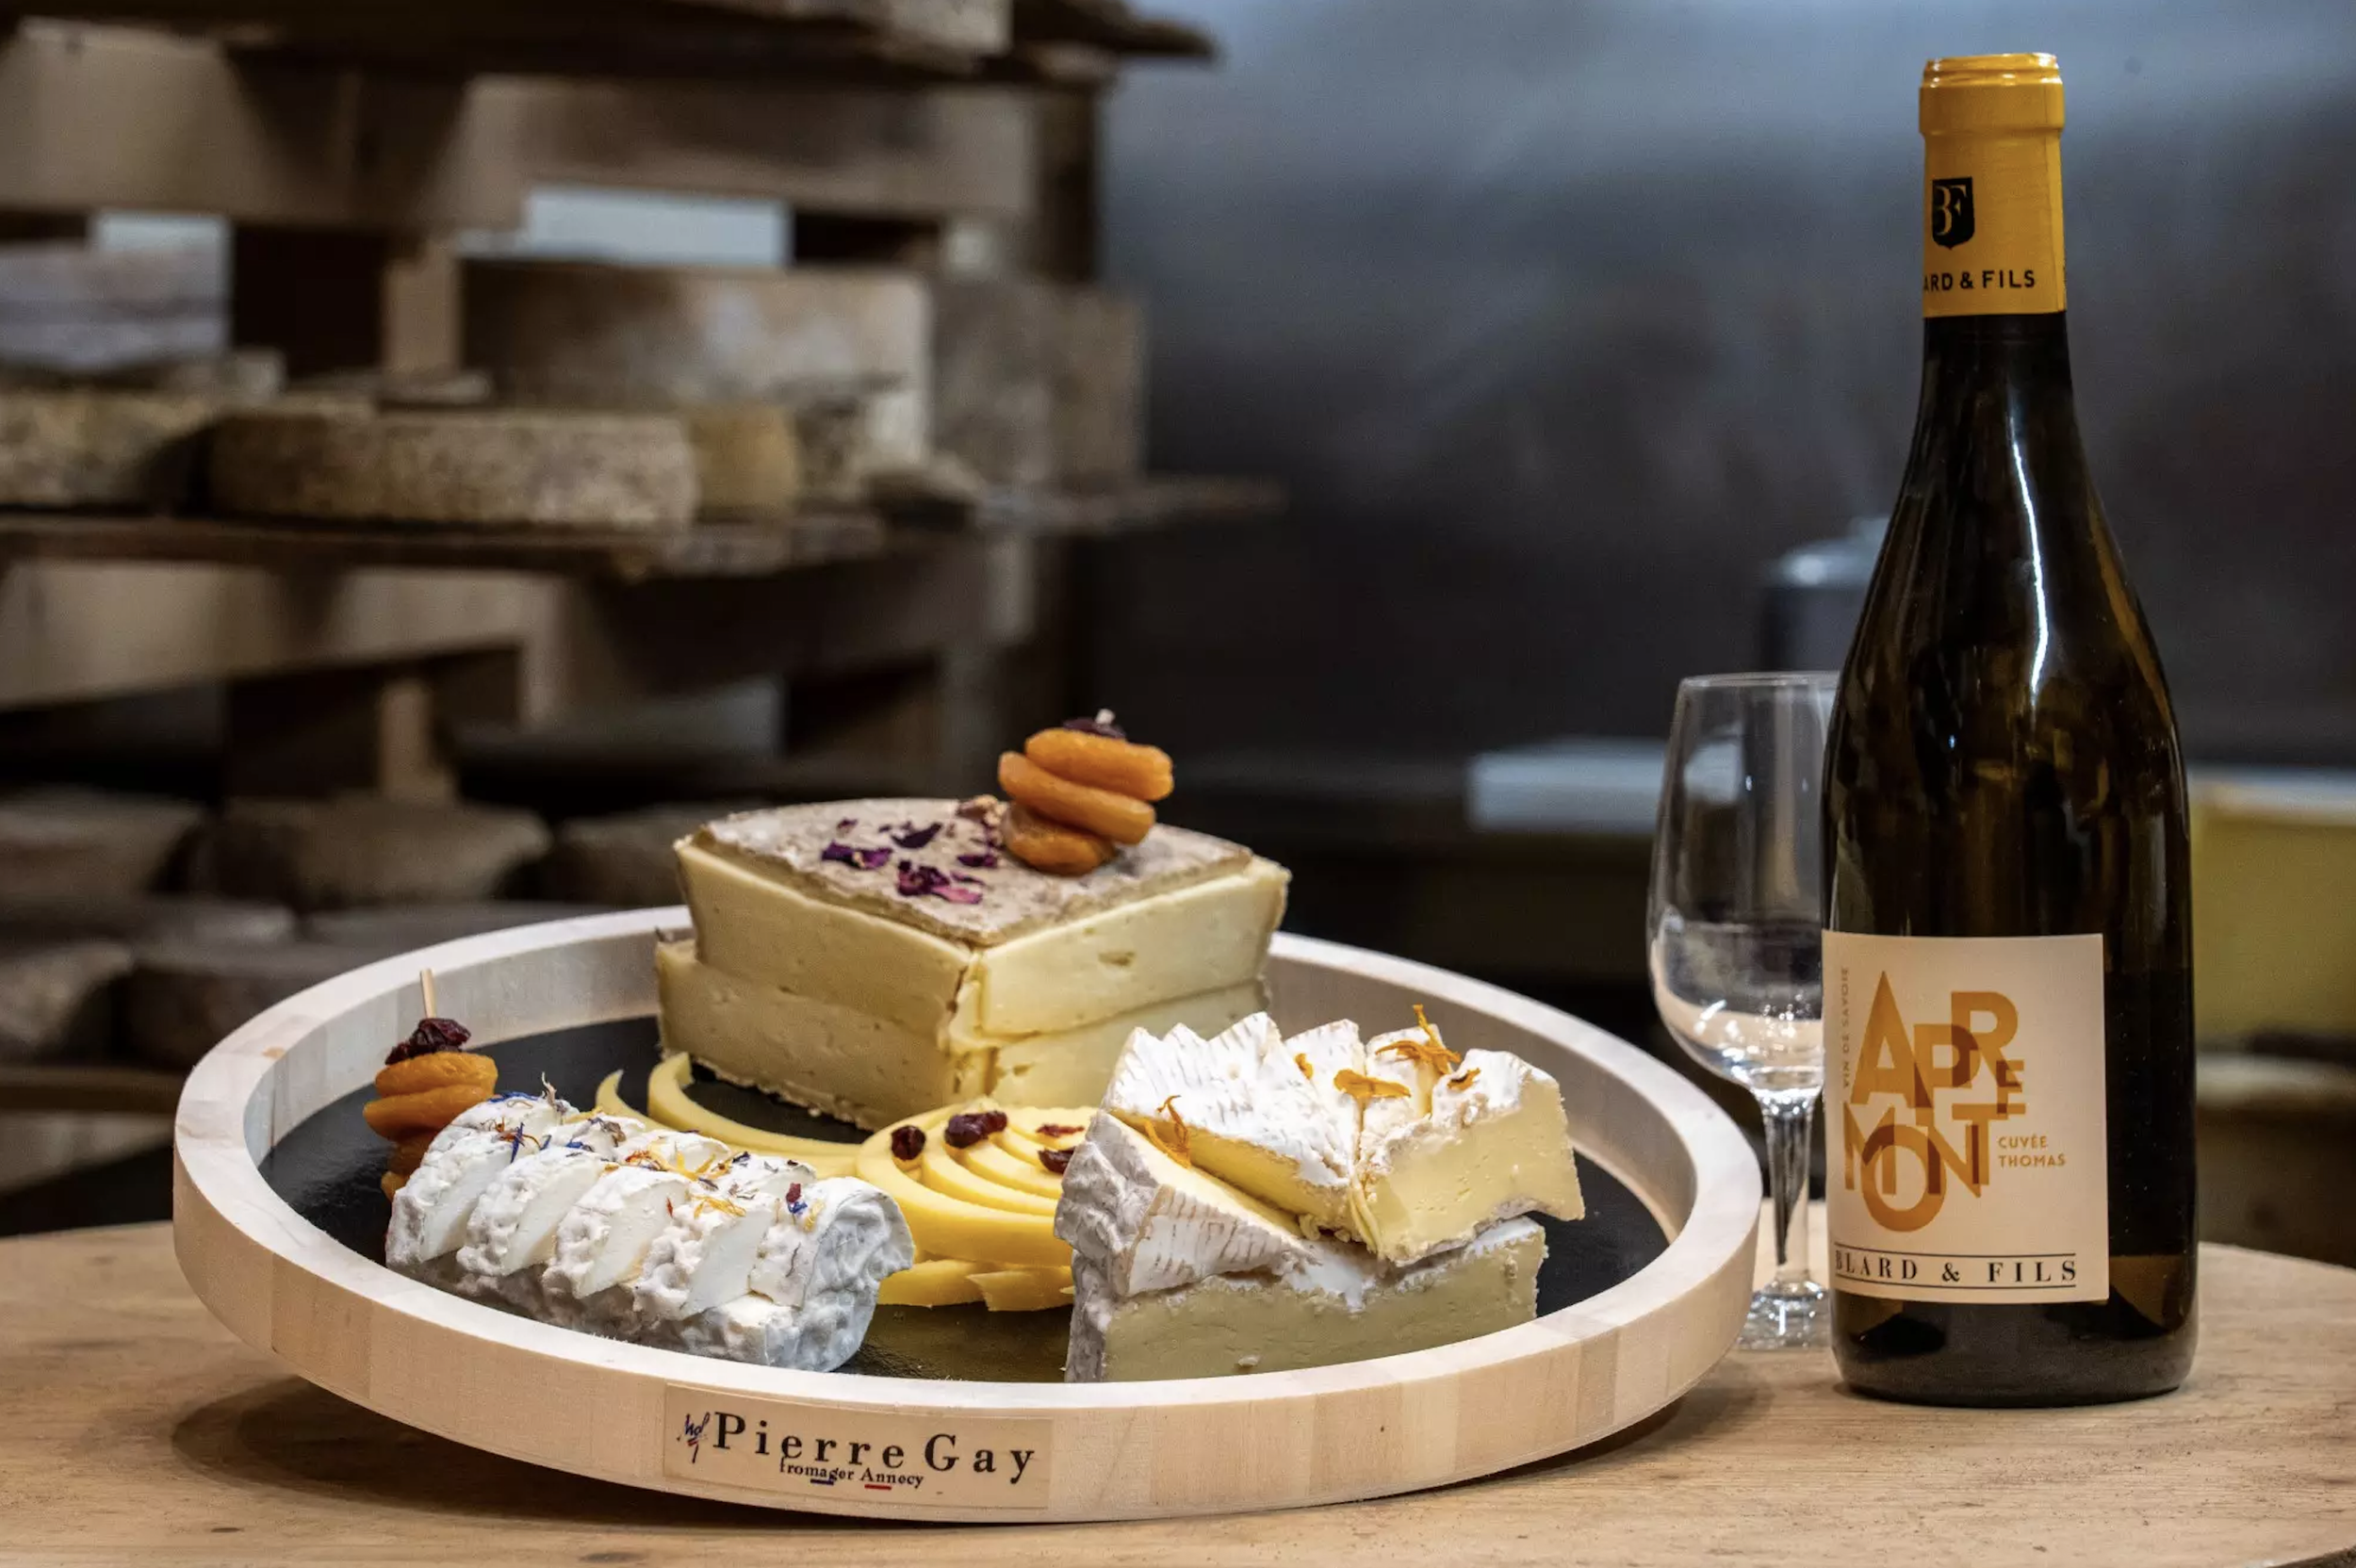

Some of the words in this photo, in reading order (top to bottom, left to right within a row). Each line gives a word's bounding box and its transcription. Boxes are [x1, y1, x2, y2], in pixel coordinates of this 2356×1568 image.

[1960, 271, 1973, 289] &
[1982, 270, 2036, 288] FILS
[1841, 966, 1849, 1027] SAVOIE
[1841, 1034, 1849, 1054] DE
[1998, 1133, 2049, 1150] CUVÉE
[1998, 1153, 2067, 1168] THOMAS
[1835, 1250, 1918, 1280] BLARD
[1941, 1263, 1960, 1282] &
[1988, 1260, 2076, 1282] FILS
[712, 1412, 905, 1469] Pierre
[924, 1433, 1036, 1484] Gay
[779, 1457, 855, 1481] fromager
[860, 1467, 924, 1489] Annecy
